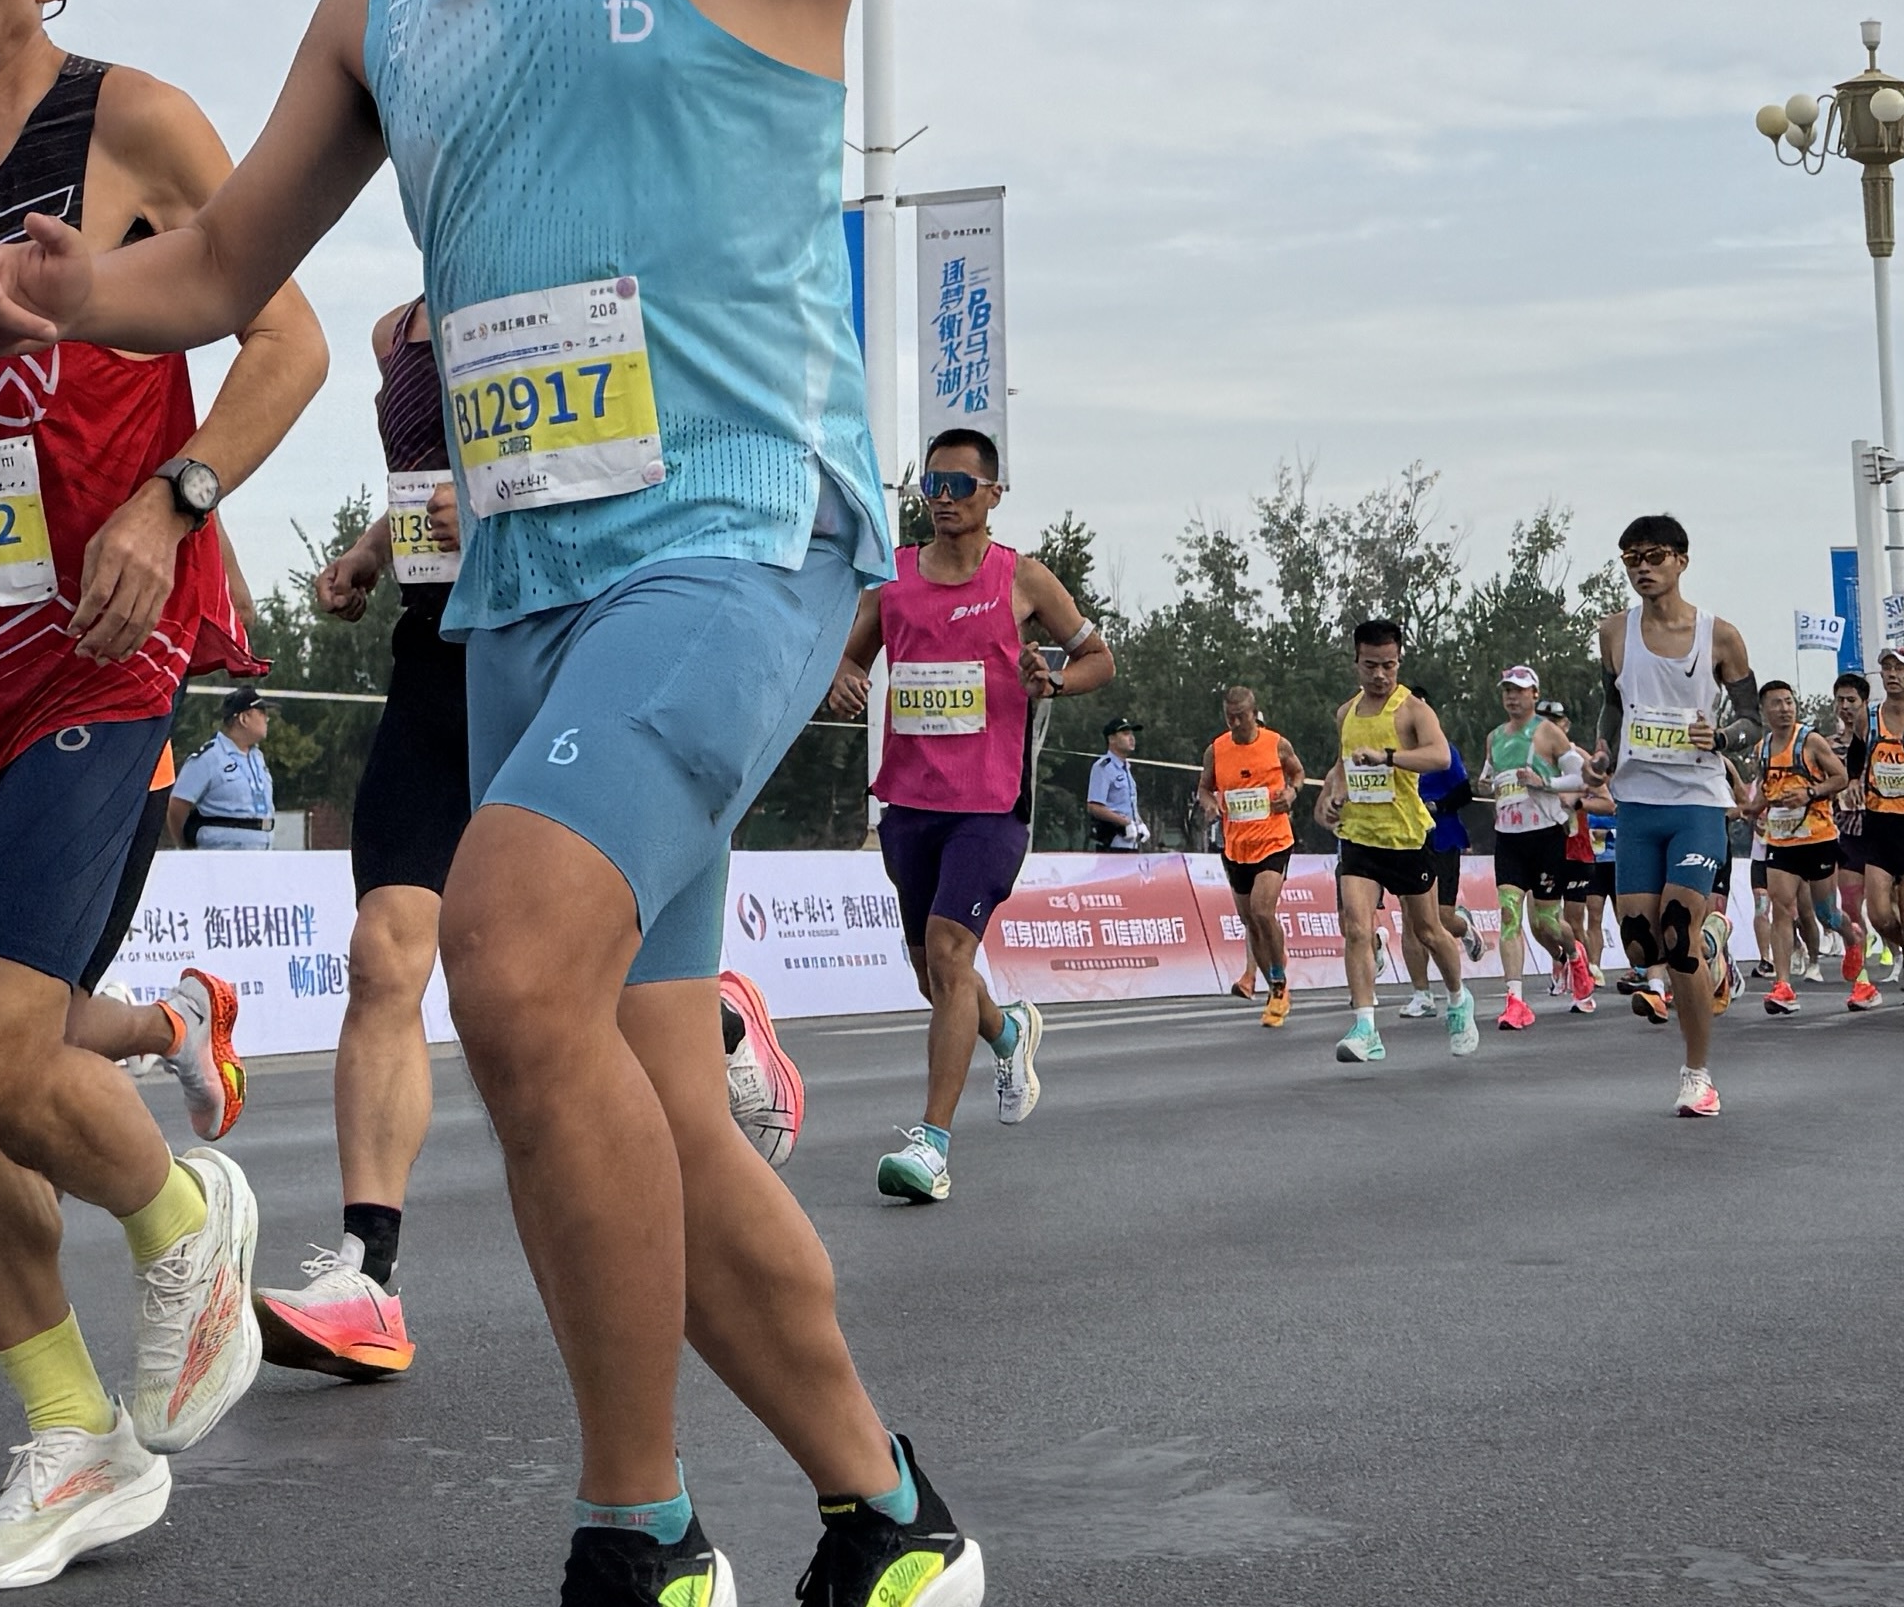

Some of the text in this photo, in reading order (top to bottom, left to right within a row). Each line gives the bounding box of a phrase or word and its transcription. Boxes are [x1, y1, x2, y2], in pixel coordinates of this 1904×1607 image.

[590, 302, 618, 319] 208
[455, 363, 613, 445] B12917
[899, 689, 974, 709] B18019
[1635, 725, 1692, 745] B1772
[202, 903, 319, 950] 衡银相伴
